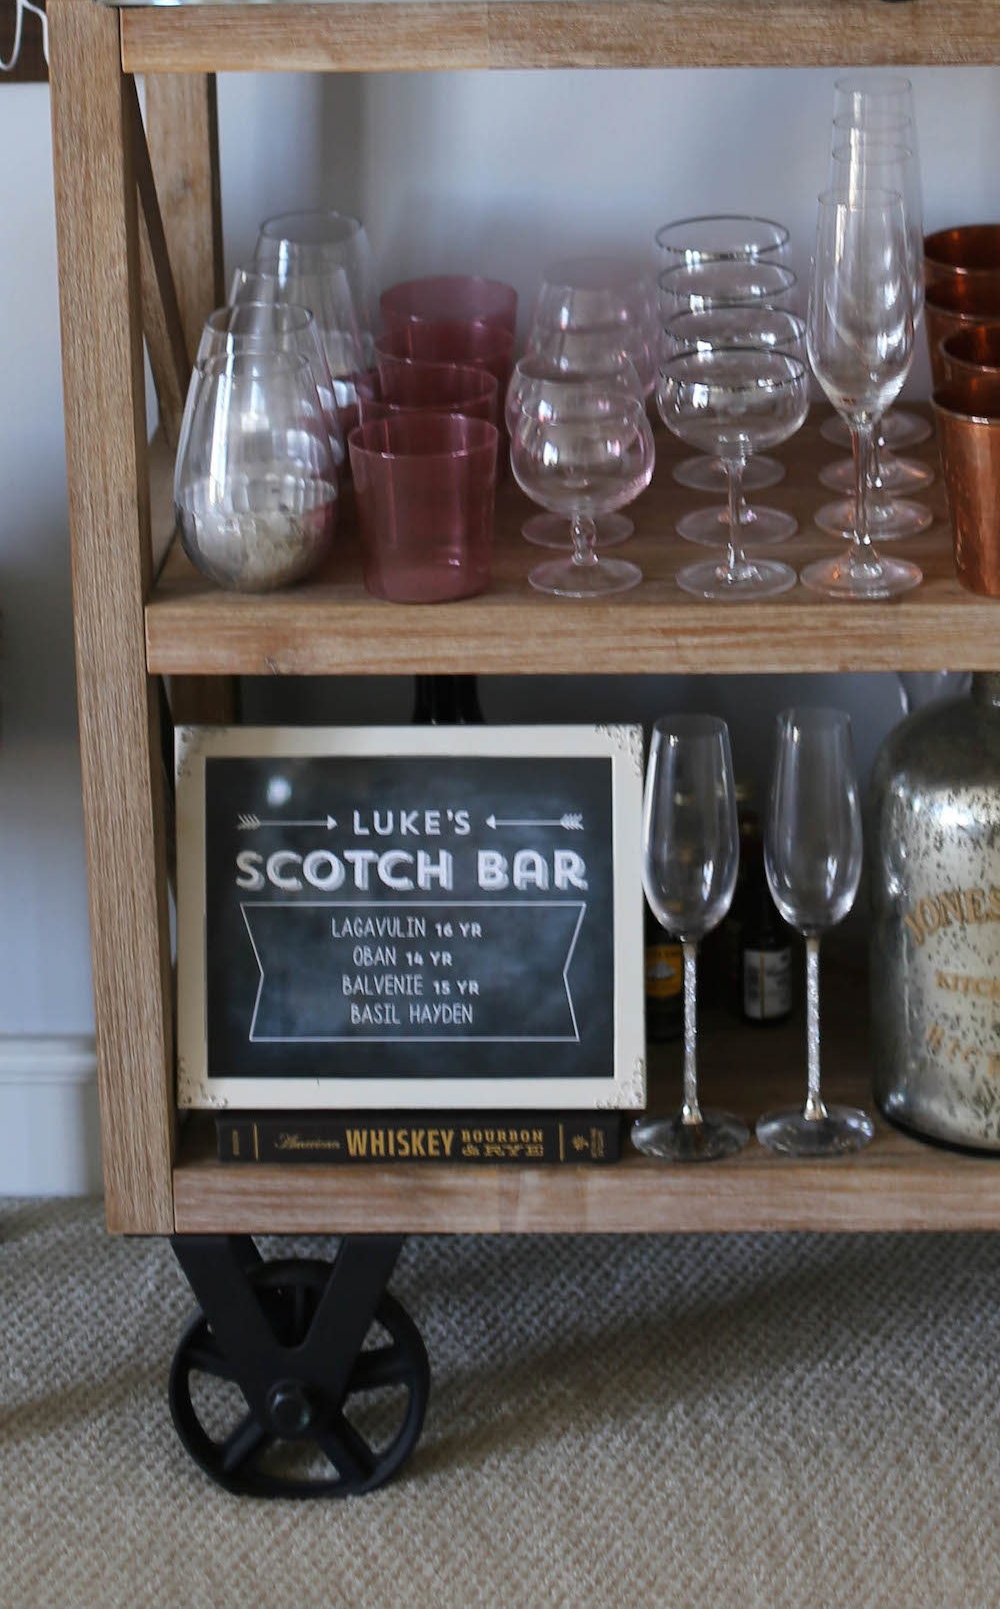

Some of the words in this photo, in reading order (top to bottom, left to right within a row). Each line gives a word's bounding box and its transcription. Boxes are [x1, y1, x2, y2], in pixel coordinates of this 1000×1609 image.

[353, 809, 471, 836] LUKE'S
[235, 848, 453, 890] SCOTCH
[477, 849, 588, 890] BAR
[331, 916, 427, 939] LAGAVULIN
[435, 922, 453, 938] 16
[459, 922, 482, 938] YR
[352, 945, 397, 967] OBAN
[405, 951, 424, 967] 14
[429, 951, 453, 967] YR
[342, 973, 424, 996] BALVENIE
[433, 980, 451, 996] 15
[456, 980, 480, 996] YR
[350, 1003, 401, 1025] BASIL
[409, 1003, 473, 1025] HAYDEN
[346, 1128, 454, 1158] WHISKEY
[461, 1129, 544, 1144] BOURBON
[461, 1143, 480, 1158] &
[483, 1143, 544, 1158] RYE
